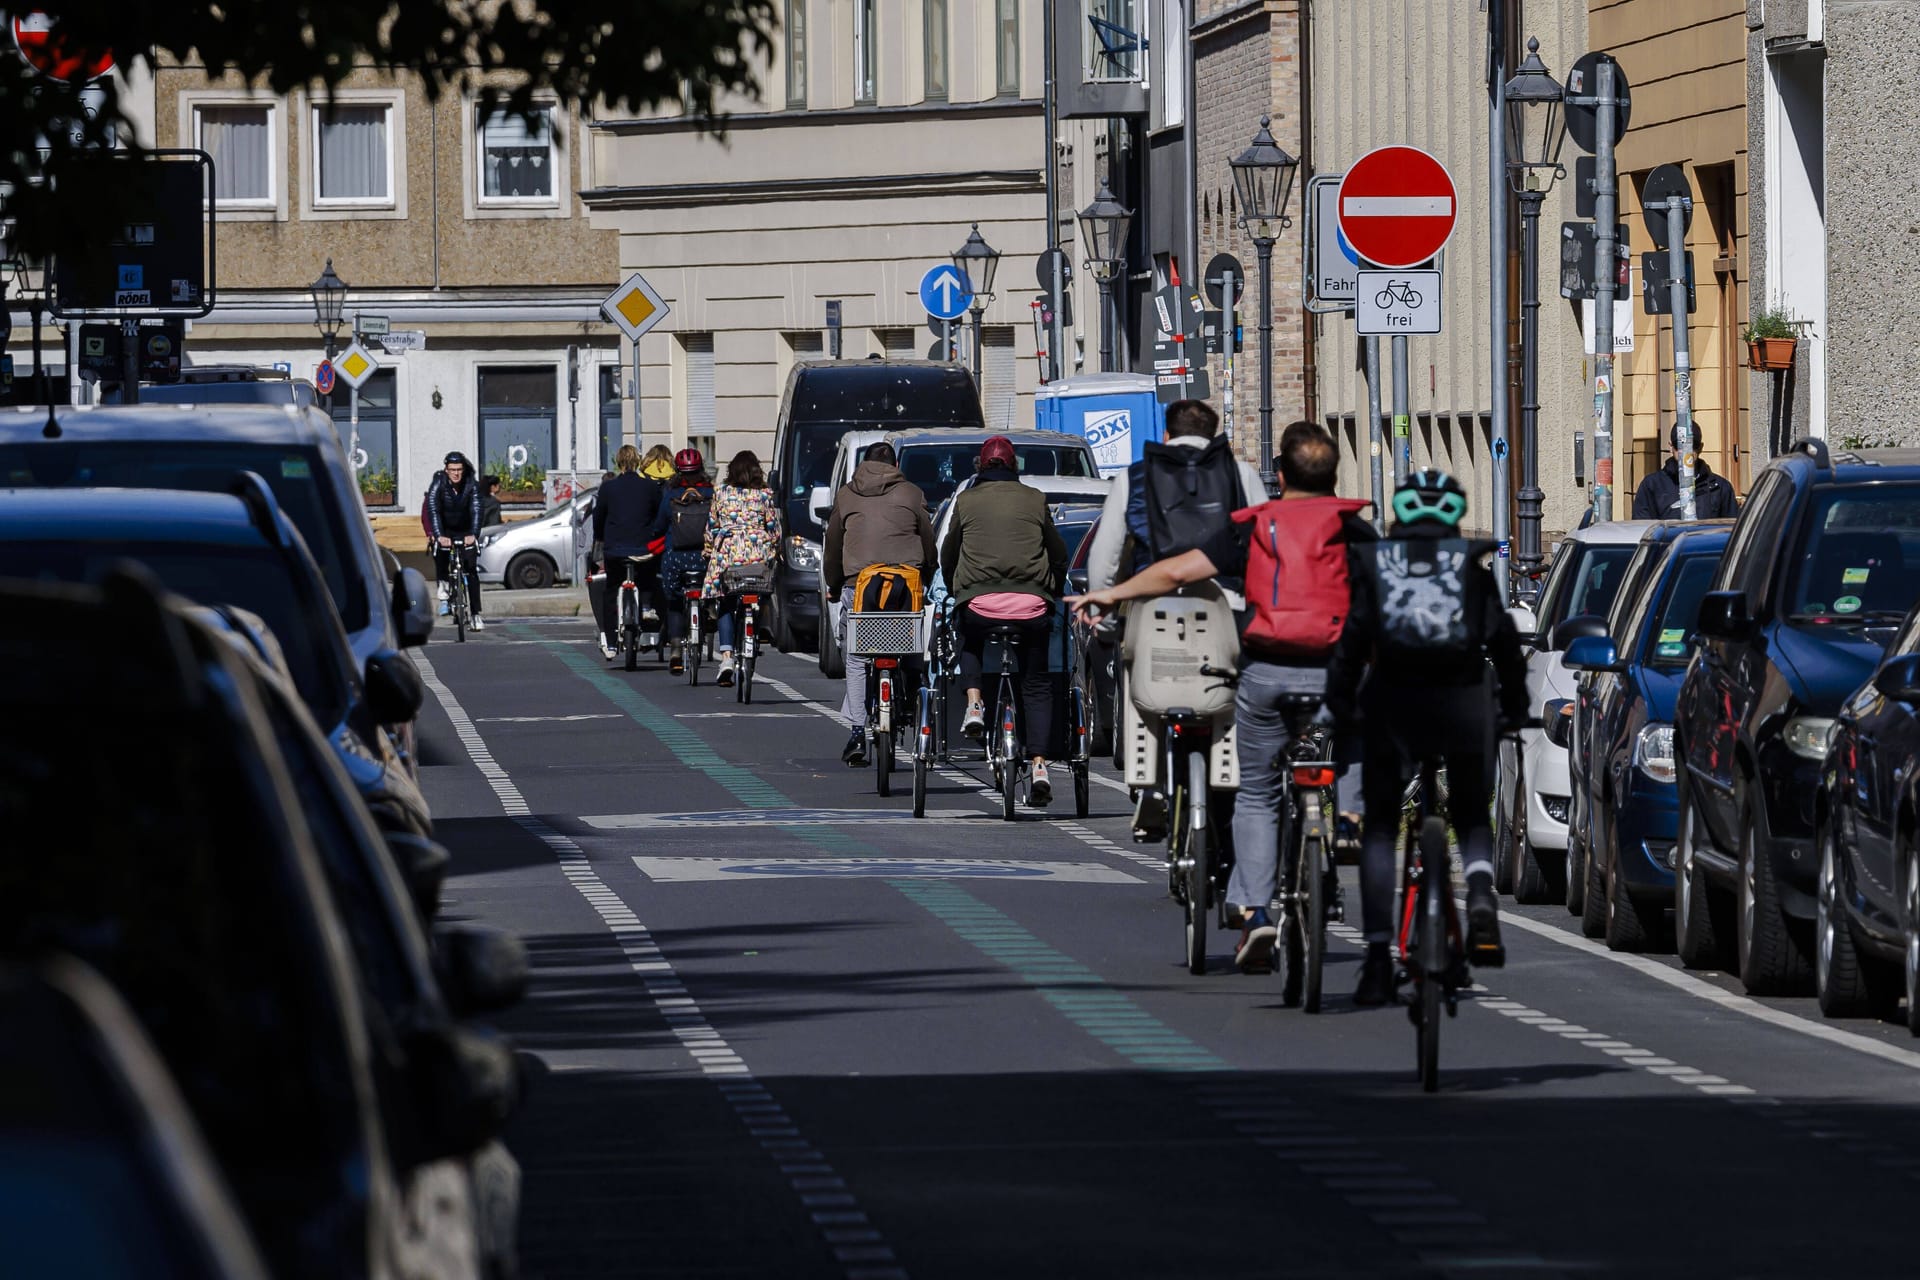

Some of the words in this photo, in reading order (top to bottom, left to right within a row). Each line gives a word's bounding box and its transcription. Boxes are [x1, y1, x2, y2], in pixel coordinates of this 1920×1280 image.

[1324, 278, 1356, 291] Fahr
[117, 291, 149, 305] RÖDEL
[1386, 313, 1413, 326] frei
[379, 334, 417, 346] kerstraße
